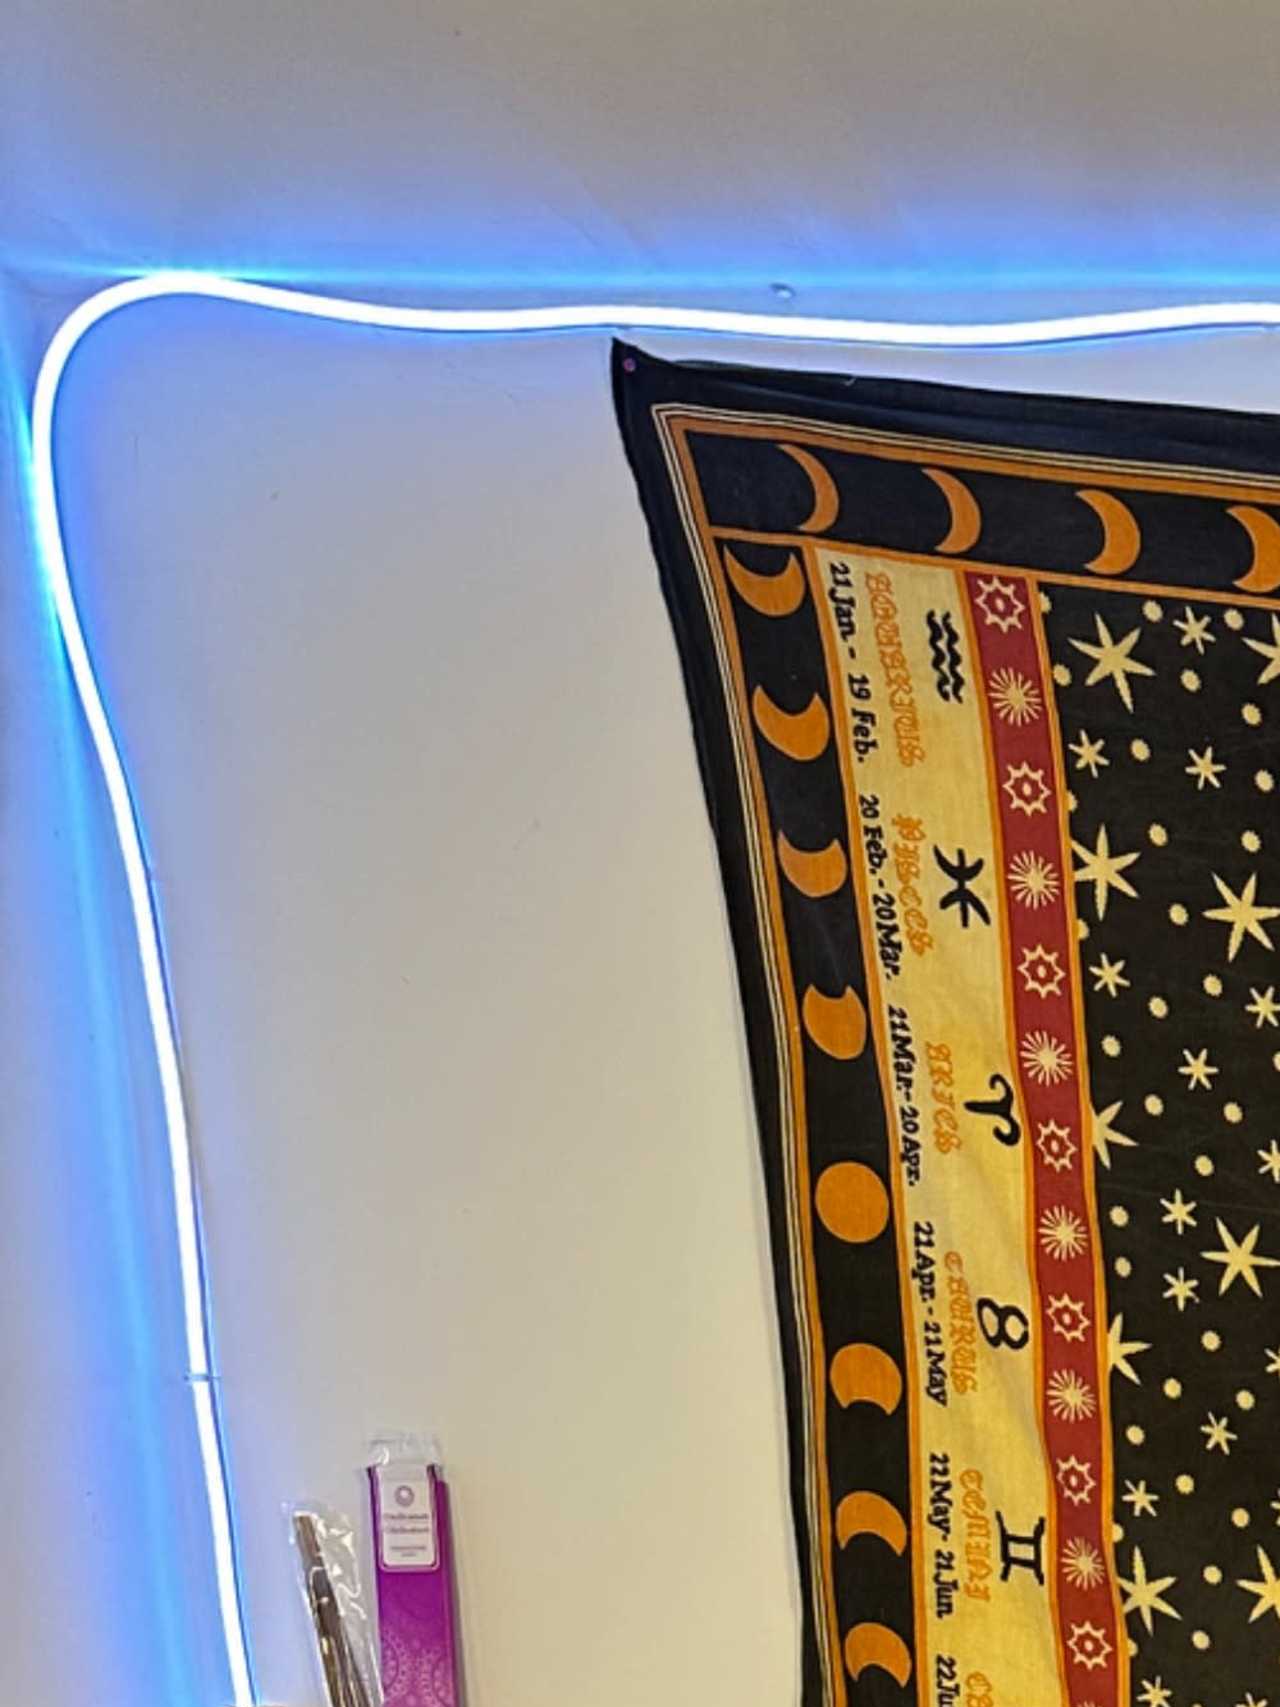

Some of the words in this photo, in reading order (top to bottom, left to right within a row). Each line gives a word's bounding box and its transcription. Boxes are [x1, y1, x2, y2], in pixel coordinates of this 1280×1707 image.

[848, 673, 872, 699] 19
[852, 708, 878, 763] Feb.
[858, 795, 880, 818] 20
